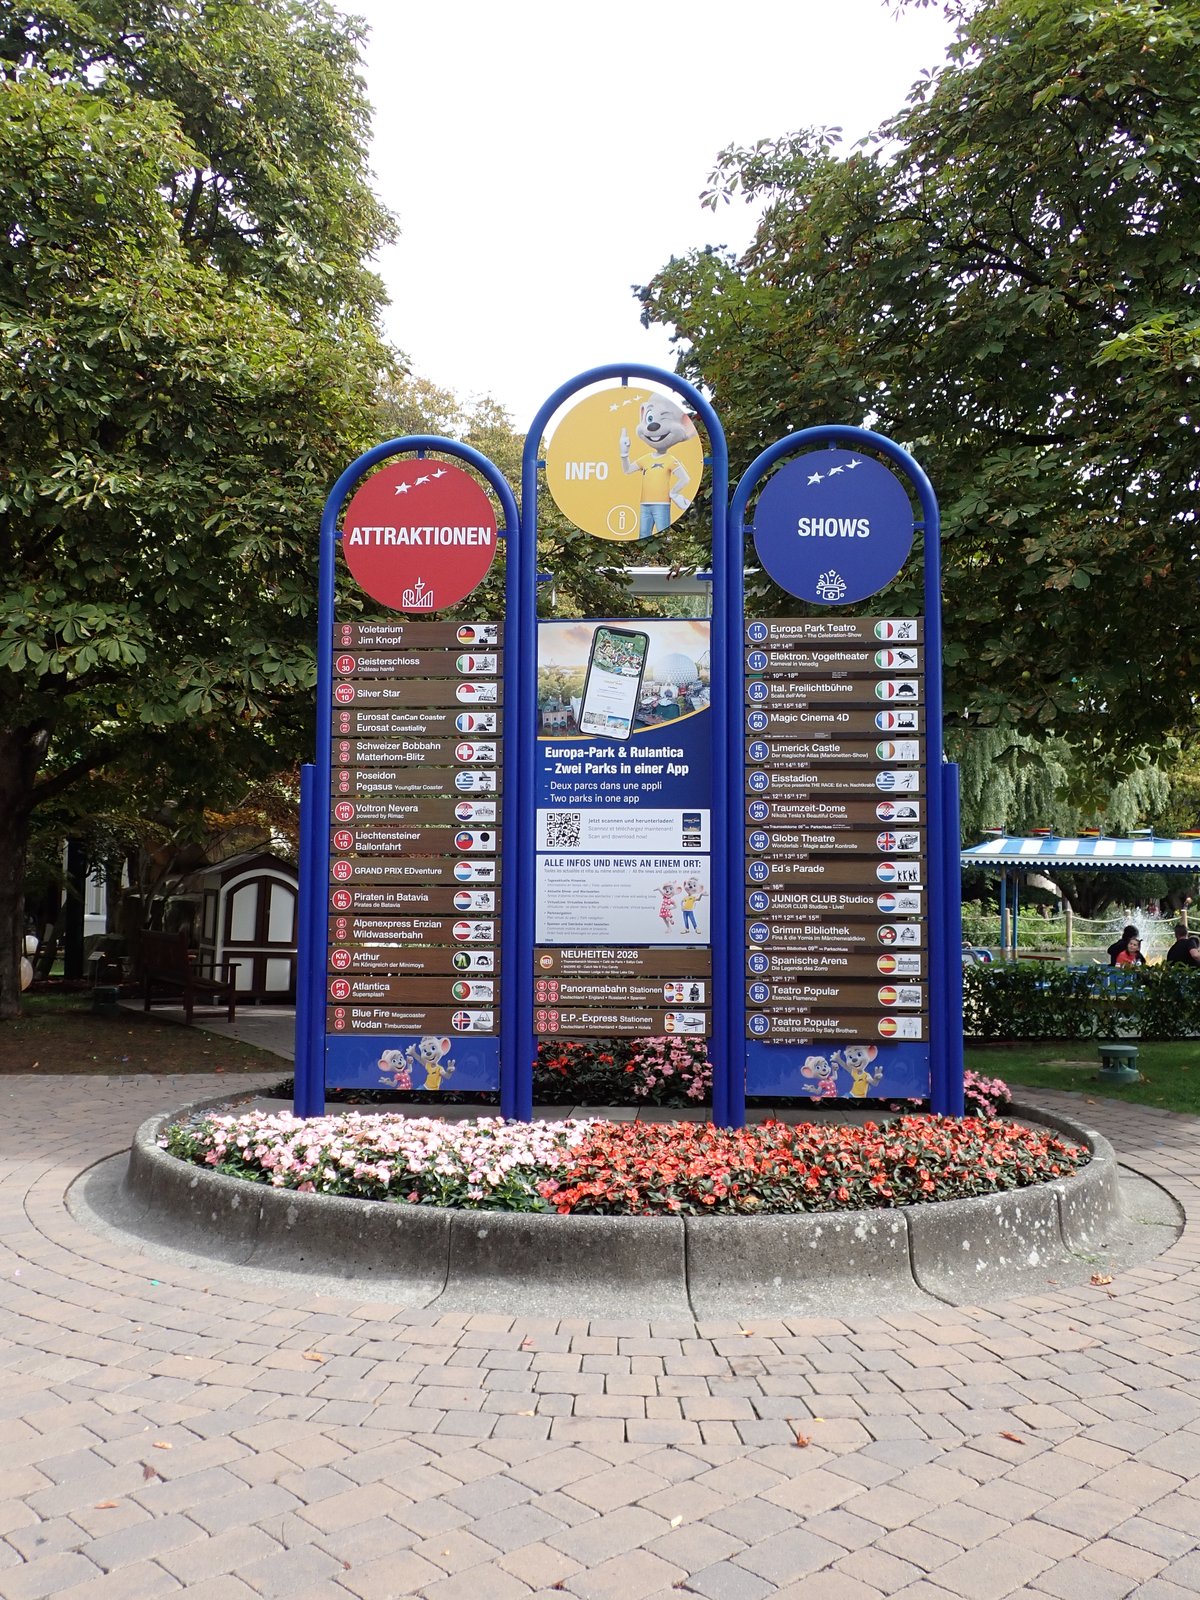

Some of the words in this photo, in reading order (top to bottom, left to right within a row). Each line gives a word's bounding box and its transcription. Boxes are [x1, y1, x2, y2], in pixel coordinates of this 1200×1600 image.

[565, 462, 608, 480] INFO
[798, 517, 870, 538] SHOWS
[349, 525, 491, 547] ATTRAKTIONEN
[358, 625, 403, 633] Voletarium
[771, 625, 802, 633] Europa
[804, 624, 825, 632] Park
[827, 624, 856, 632] Teatro
[375, 636, 401, 645] Knopf
[812, 653, 869, 662] Vogeltheater
[771, 684, 787, 692] Ital.
[790, 684, 852, 692] Freilichtbühne
[357, 713, 389, 721] Eurosat
[771, 714, 798, 723] Magic
[357, 724, 389, 732] Eurosat
[391, 725, 426, 733] Coastiality
[357, 742, 400, 750] Schweizer
[402, 742, 441, 750] Bobbahn
[772, 744, 811, 752] Limerick
[814, 744, 840, 752] Castle
[357, 753, 425, 761] Matterhorn-Blitz
[545, 747, 615, 760] Europa-Park
[618, 747, 627, 758] &
[630, 747, 683, 758] Rulantica
[555, 763, 581, 774] Zwei
[585, 763, 617, 774] Parks
[621, 763, 631, 774] in
[634, 763, 663, 774] einer
[666, 763, 689, 776] App
[357, 772, 396, 780] Poseidon
[357, 783, 392, 792] Pegasus
[551, 781, 572, 789] Deux
[574, 783, 597, 791] parcs
[600, 781, 620, 789] dans
[641, 782, 662, 791] appli
[551, 794, 566, 802] Two
[569, 794, 592, 804] parks
[595, 794, 602, 802] in
[623, 795, 639, 804] app
[356, 804, 386, 812] Voltron
[388, 804, 418, 812] Nevera
[772, 804, 846, 812] Traumzeit-Dome
[772, 834, 799, 842] Globe
[544, 859, 564, 867] ALLE
[567, 859, 591, 867] INFOS
[594, 859, 610, 867] UND
[613, 859, 637, 867] NEWS
[640, 859, 652, 867] AN
[654, 859, 680, 867] EINEM
[683, 859, 701, 868] ORT:
[354, 893, 384, 901] Piraten
[387, 893, 394, 901] in
[397, 893, 429, 901] Batavia
[772, 895, 809, 903] JUNIOR
[811, 895, 837, 903] CLUB
[353, 919, 411, 929] Alpenexpress
[413, 920, 441, 928] Enzian
[353, 931, 423, 939] Wildwasserbahn
[772, 926, 802, 934] Grimm
[805, 927, 849, 935] Bibliothek
[353, 953, 380, 961] Arthur
[561, 951, 615, 959] NEUHEITEN
[617, 951, 638, 959] 2026
[772, 957, 818, 966] Spanische
[821, 957, 847, 965] Arena
[560, 985, 627, 993] Panoramabahn
[772, 986, 801, 994] Teatro
[804, 987, 839, 996] Popular
[352, 1010, 371, 1018] Blue
[374, 1010, 390, 1018] Fire
[561, 1014, 618, 1023] E.P.-Express
[352, 1021, 382, 1029] Wodan
[772, 1018, 801, 1026] Teatro
[804, 1018, 839, 1028] Popular
